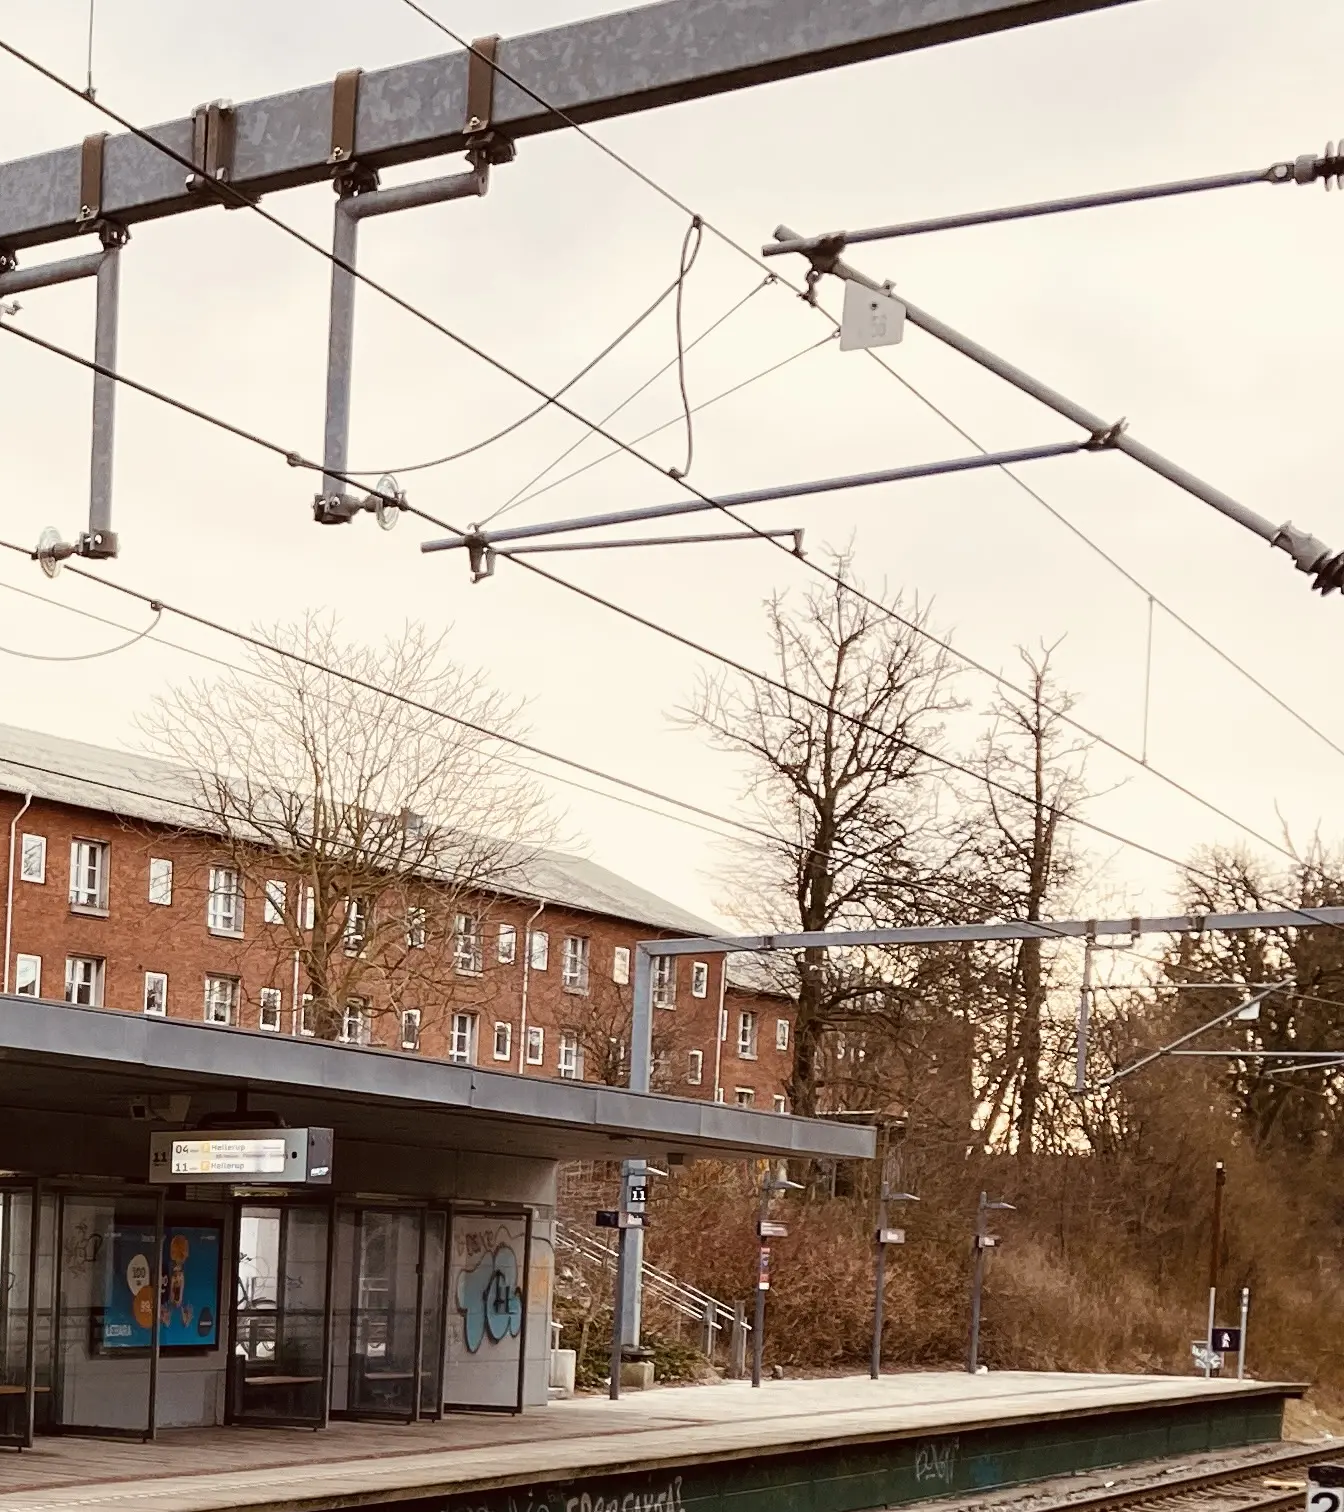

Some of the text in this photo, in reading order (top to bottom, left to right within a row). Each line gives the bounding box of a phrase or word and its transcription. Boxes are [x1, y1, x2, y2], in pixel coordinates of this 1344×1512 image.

[175, 1144, 189, 1154] 04
[175, 1163, 189, 1172] 11
[631, 1190, 646, 1201] 11
